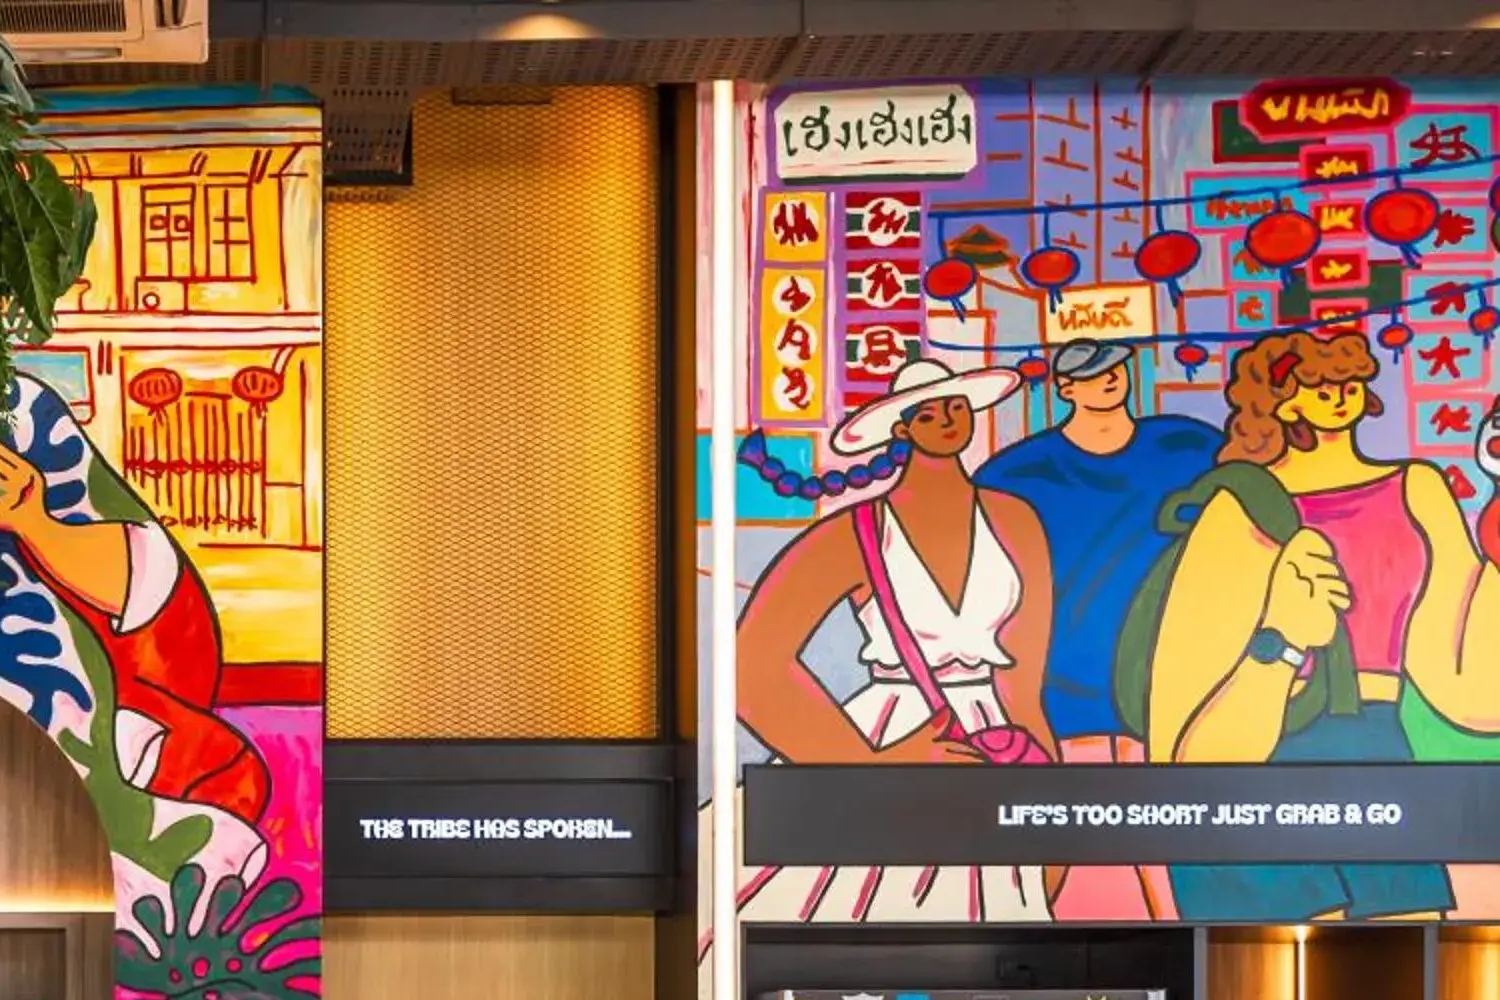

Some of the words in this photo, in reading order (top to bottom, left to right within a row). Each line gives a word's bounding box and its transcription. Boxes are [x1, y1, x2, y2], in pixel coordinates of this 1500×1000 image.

[997, 804, 1069, 826] LIFE'S
[1072, 804, 1123, 826] TOO
[1127, 804, 1209, 825] SHORT
[1211, 804, 1273, 825] JUST
[1276, 803, 1341, 825] GRAB
[1344, 804, 1363, 824] &
[1366, 803, 1402, 825] GO
[359, 818, 405, 839] THE
[408, 818, 471, 839] TRIBE
[474, 818, 521, 839] HAS
